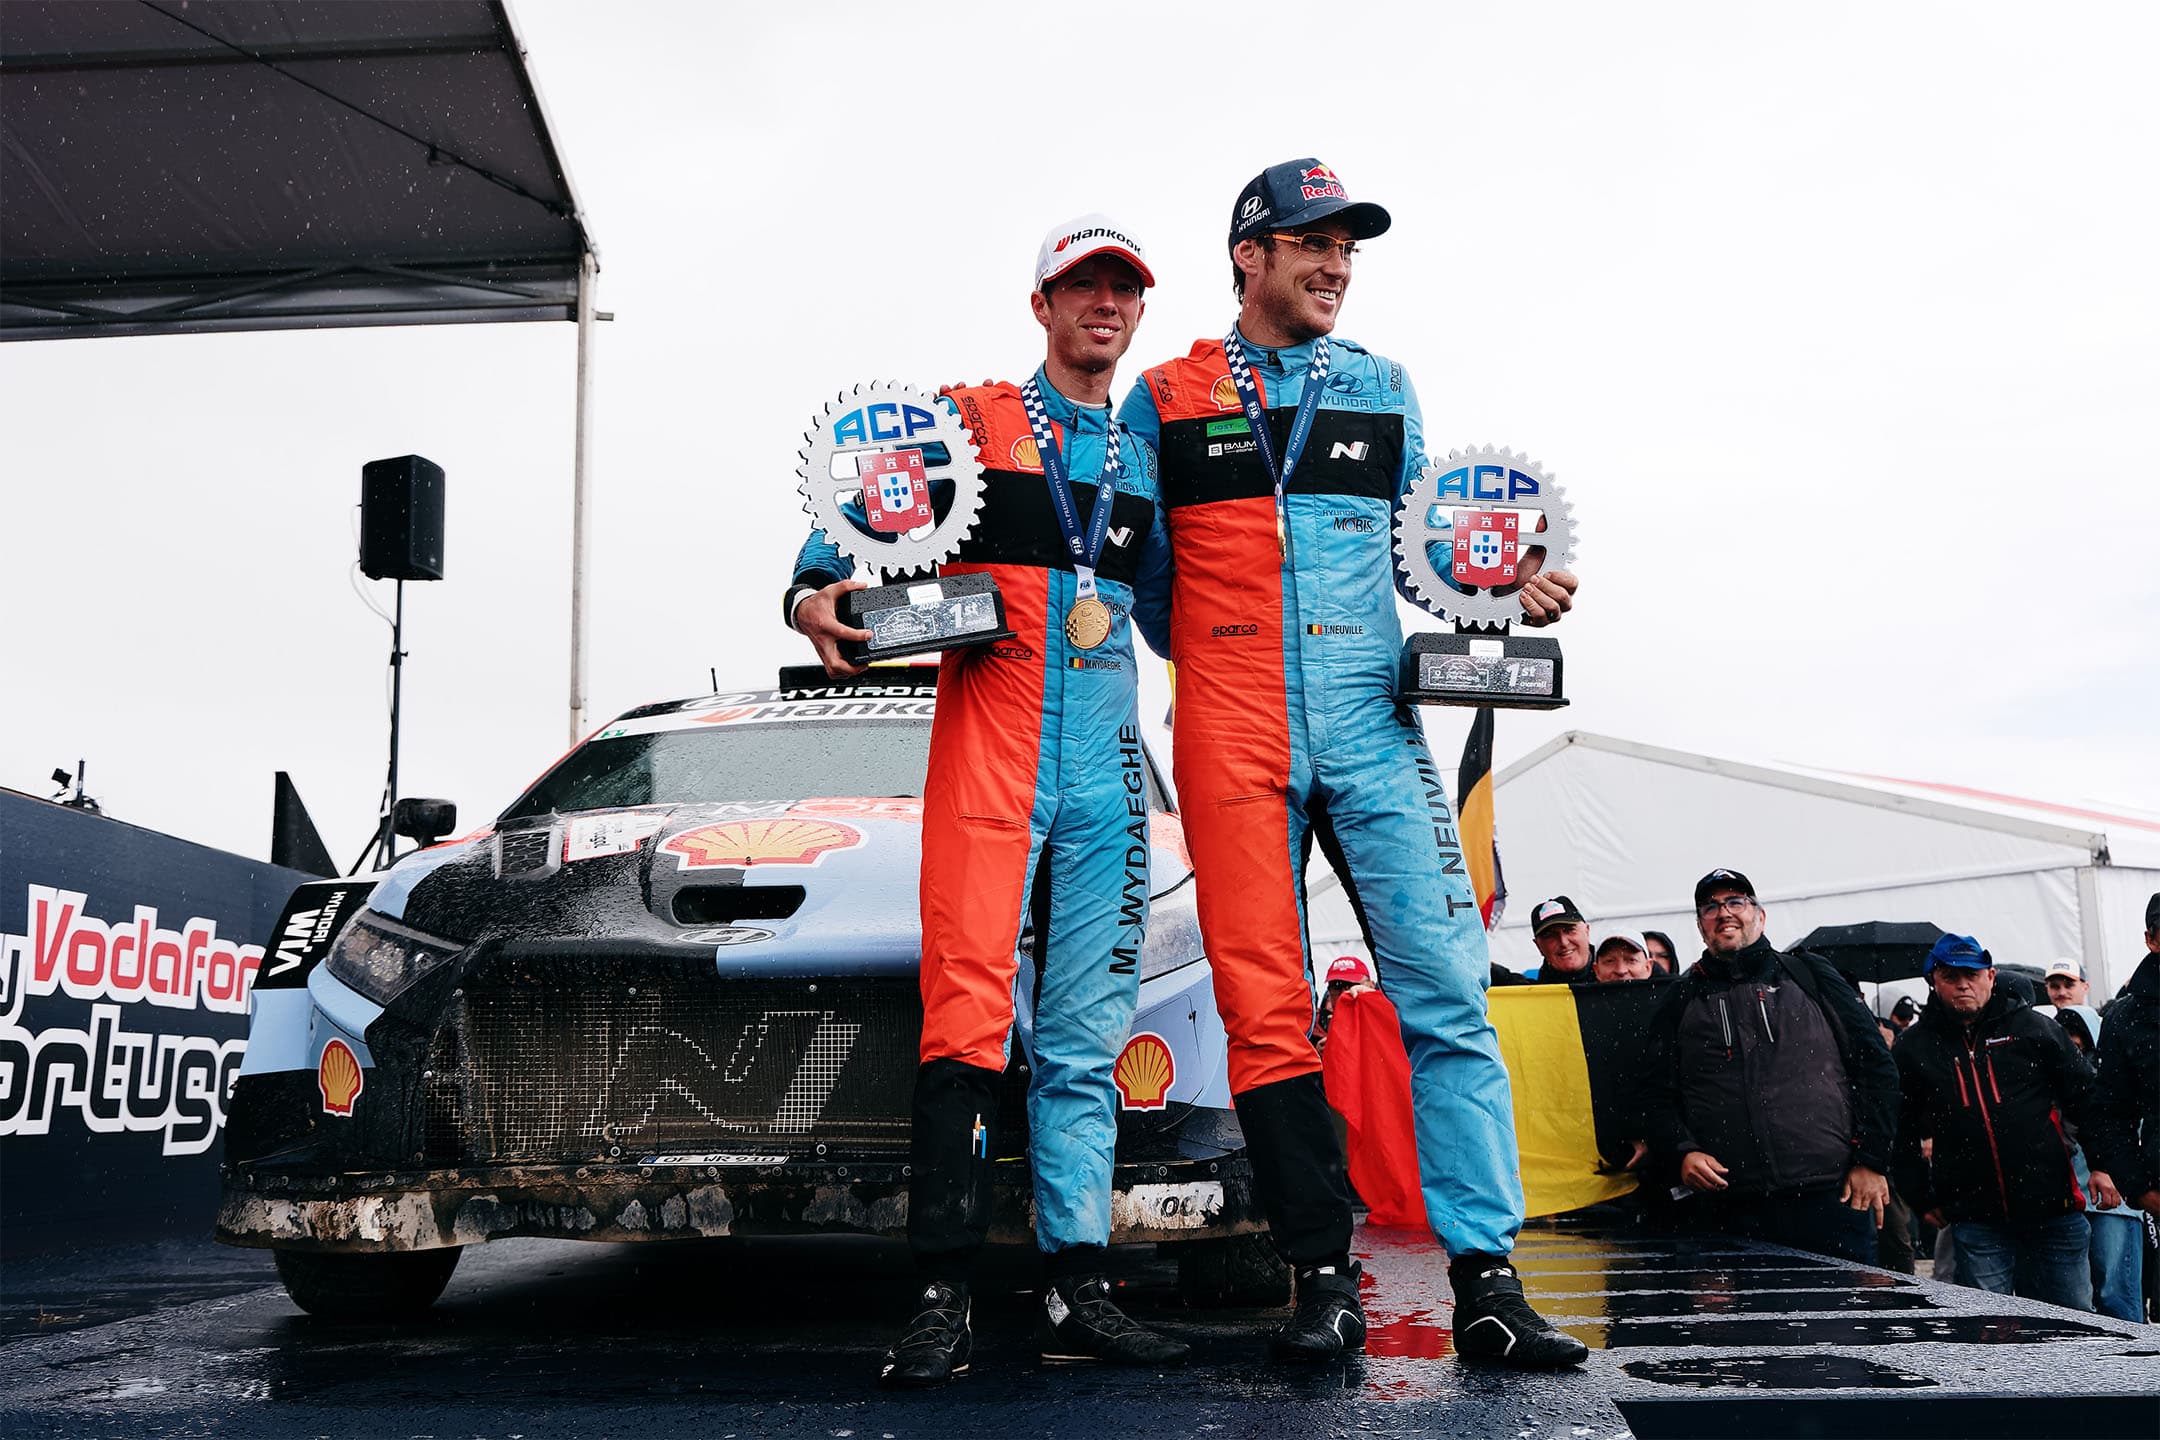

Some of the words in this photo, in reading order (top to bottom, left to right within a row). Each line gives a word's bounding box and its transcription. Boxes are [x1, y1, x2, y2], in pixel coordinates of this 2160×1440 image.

[1301, 185, 1332, 200] Red
[1238, 208, 1271, 233] HYUNDAI
[1319, 394, 1373, 409] YUNDAI
[1248, 402, 1259, 418] FIA
[833, 403, 936, 445] ACP
[961, 396, 989, 446] sparco
[1224, 441, 1257, 450] BAUM
[1437, 465, 1541, 500] ACP
[1102, 483, 1112, 499] FIA
[1322, 509, 1357, 517] HYUNDAI
[1333, 517, 1374, 533] MOBIS
[1072, 538, 1084, 555] FIA
[1101, 601, 1127, 617] OBIS
[1211, 624, 1258, 638] sparco
[1323, 625, 1363, 635] T.NEUVILLE
[991, 646, 1033, 660] parco
[1506, 663, 1537, 687] 1st
[1118, 724, 1148, 927] WYDAEGHE
[312, 891, 347, 943] HYUNDAI
[1108, 939, 1139, 975] M.
